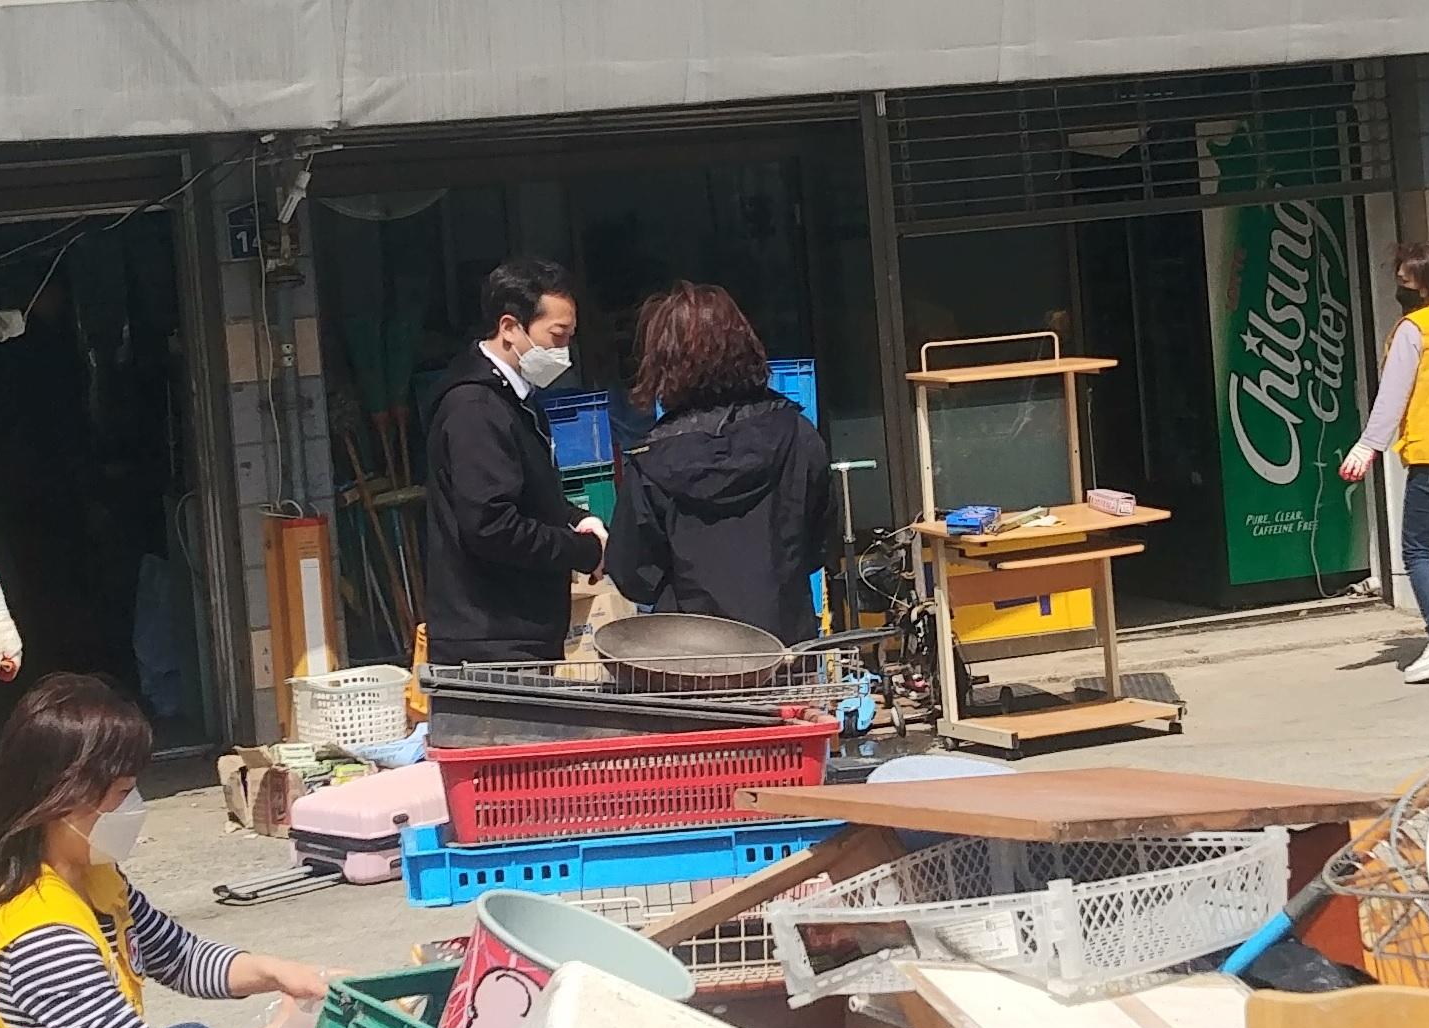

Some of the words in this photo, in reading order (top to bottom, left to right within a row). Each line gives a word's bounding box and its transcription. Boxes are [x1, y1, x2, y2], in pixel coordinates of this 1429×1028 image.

[1228, 182, 1347, 486] Chilsung
[1308, 253, 1349, 423] Cider
[1252, 523, 1295, 537] CAFFEINE
